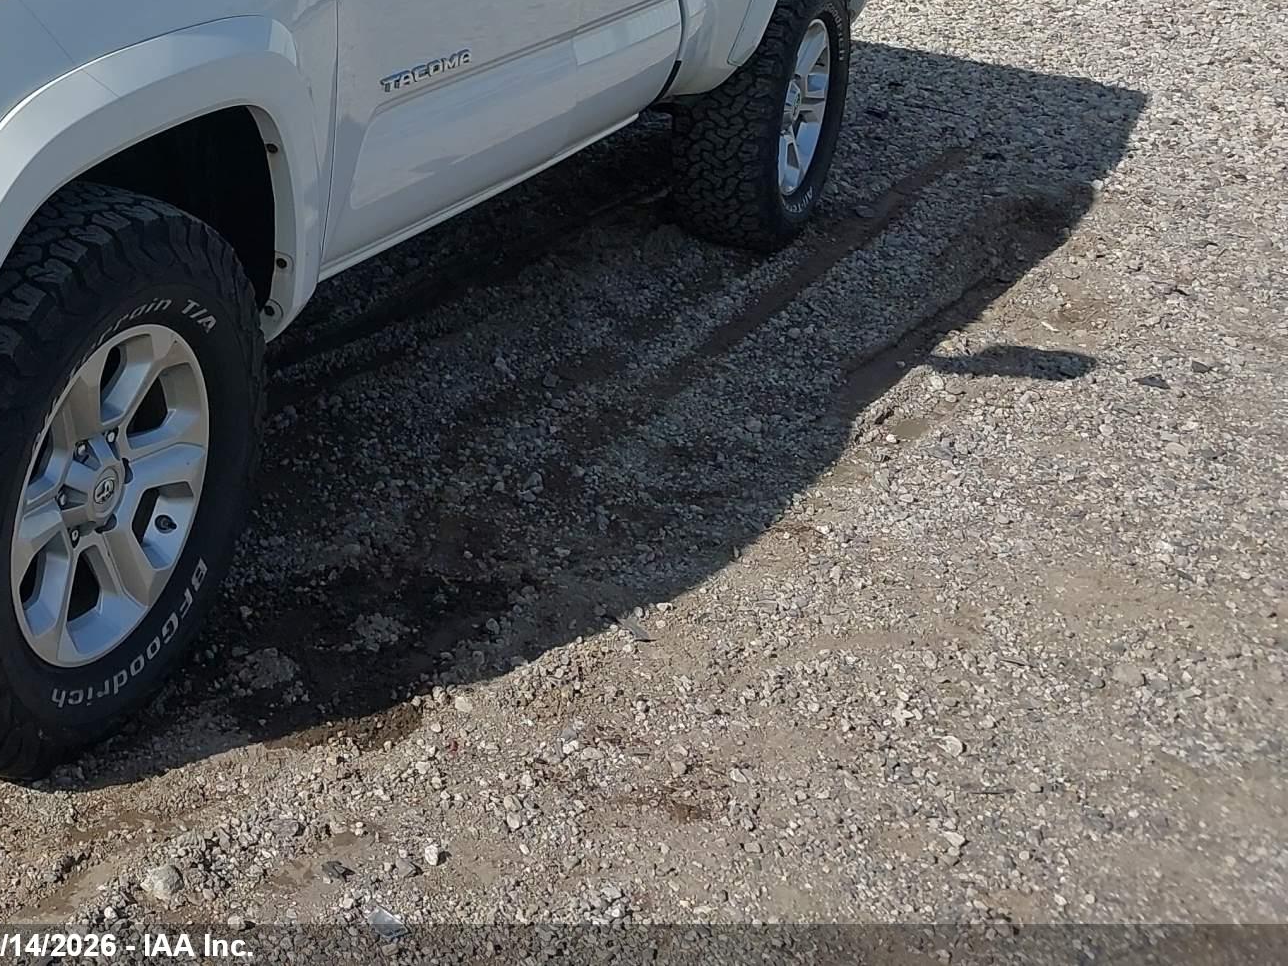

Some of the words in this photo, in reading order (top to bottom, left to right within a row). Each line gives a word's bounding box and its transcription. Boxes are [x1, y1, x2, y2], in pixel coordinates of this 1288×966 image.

[379, 48, 472, 92] TACOMA
[181, 299, 217, 334] T/A
[50, 557, 209, 708] BFGoodrich
